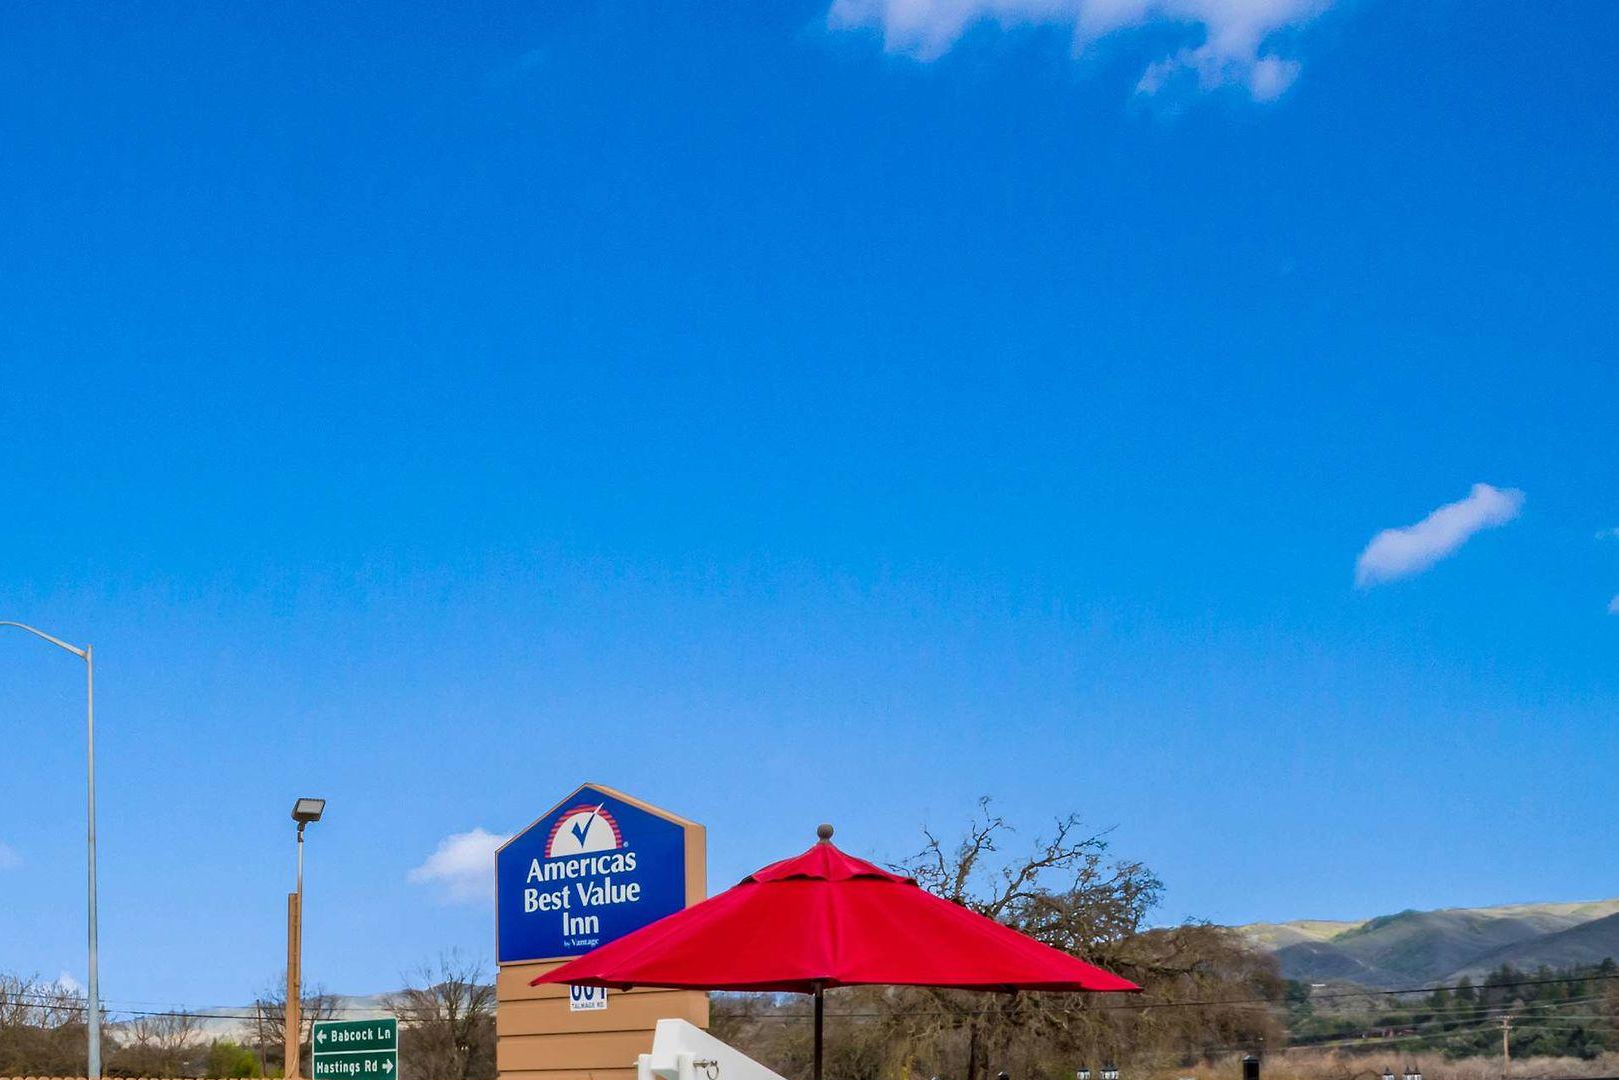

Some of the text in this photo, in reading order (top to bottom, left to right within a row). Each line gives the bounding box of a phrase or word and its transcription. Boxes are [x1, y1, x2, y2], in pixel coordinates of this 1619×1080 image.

[526, 852, 637, 883] Americas
[524, 877, 640, 913] Best Value
[563, 912, 599, 936] Inn
[331, 1027, 391, 1042] Babcock Ln
[316, 1060, 378, 1077] Hastings Rd
